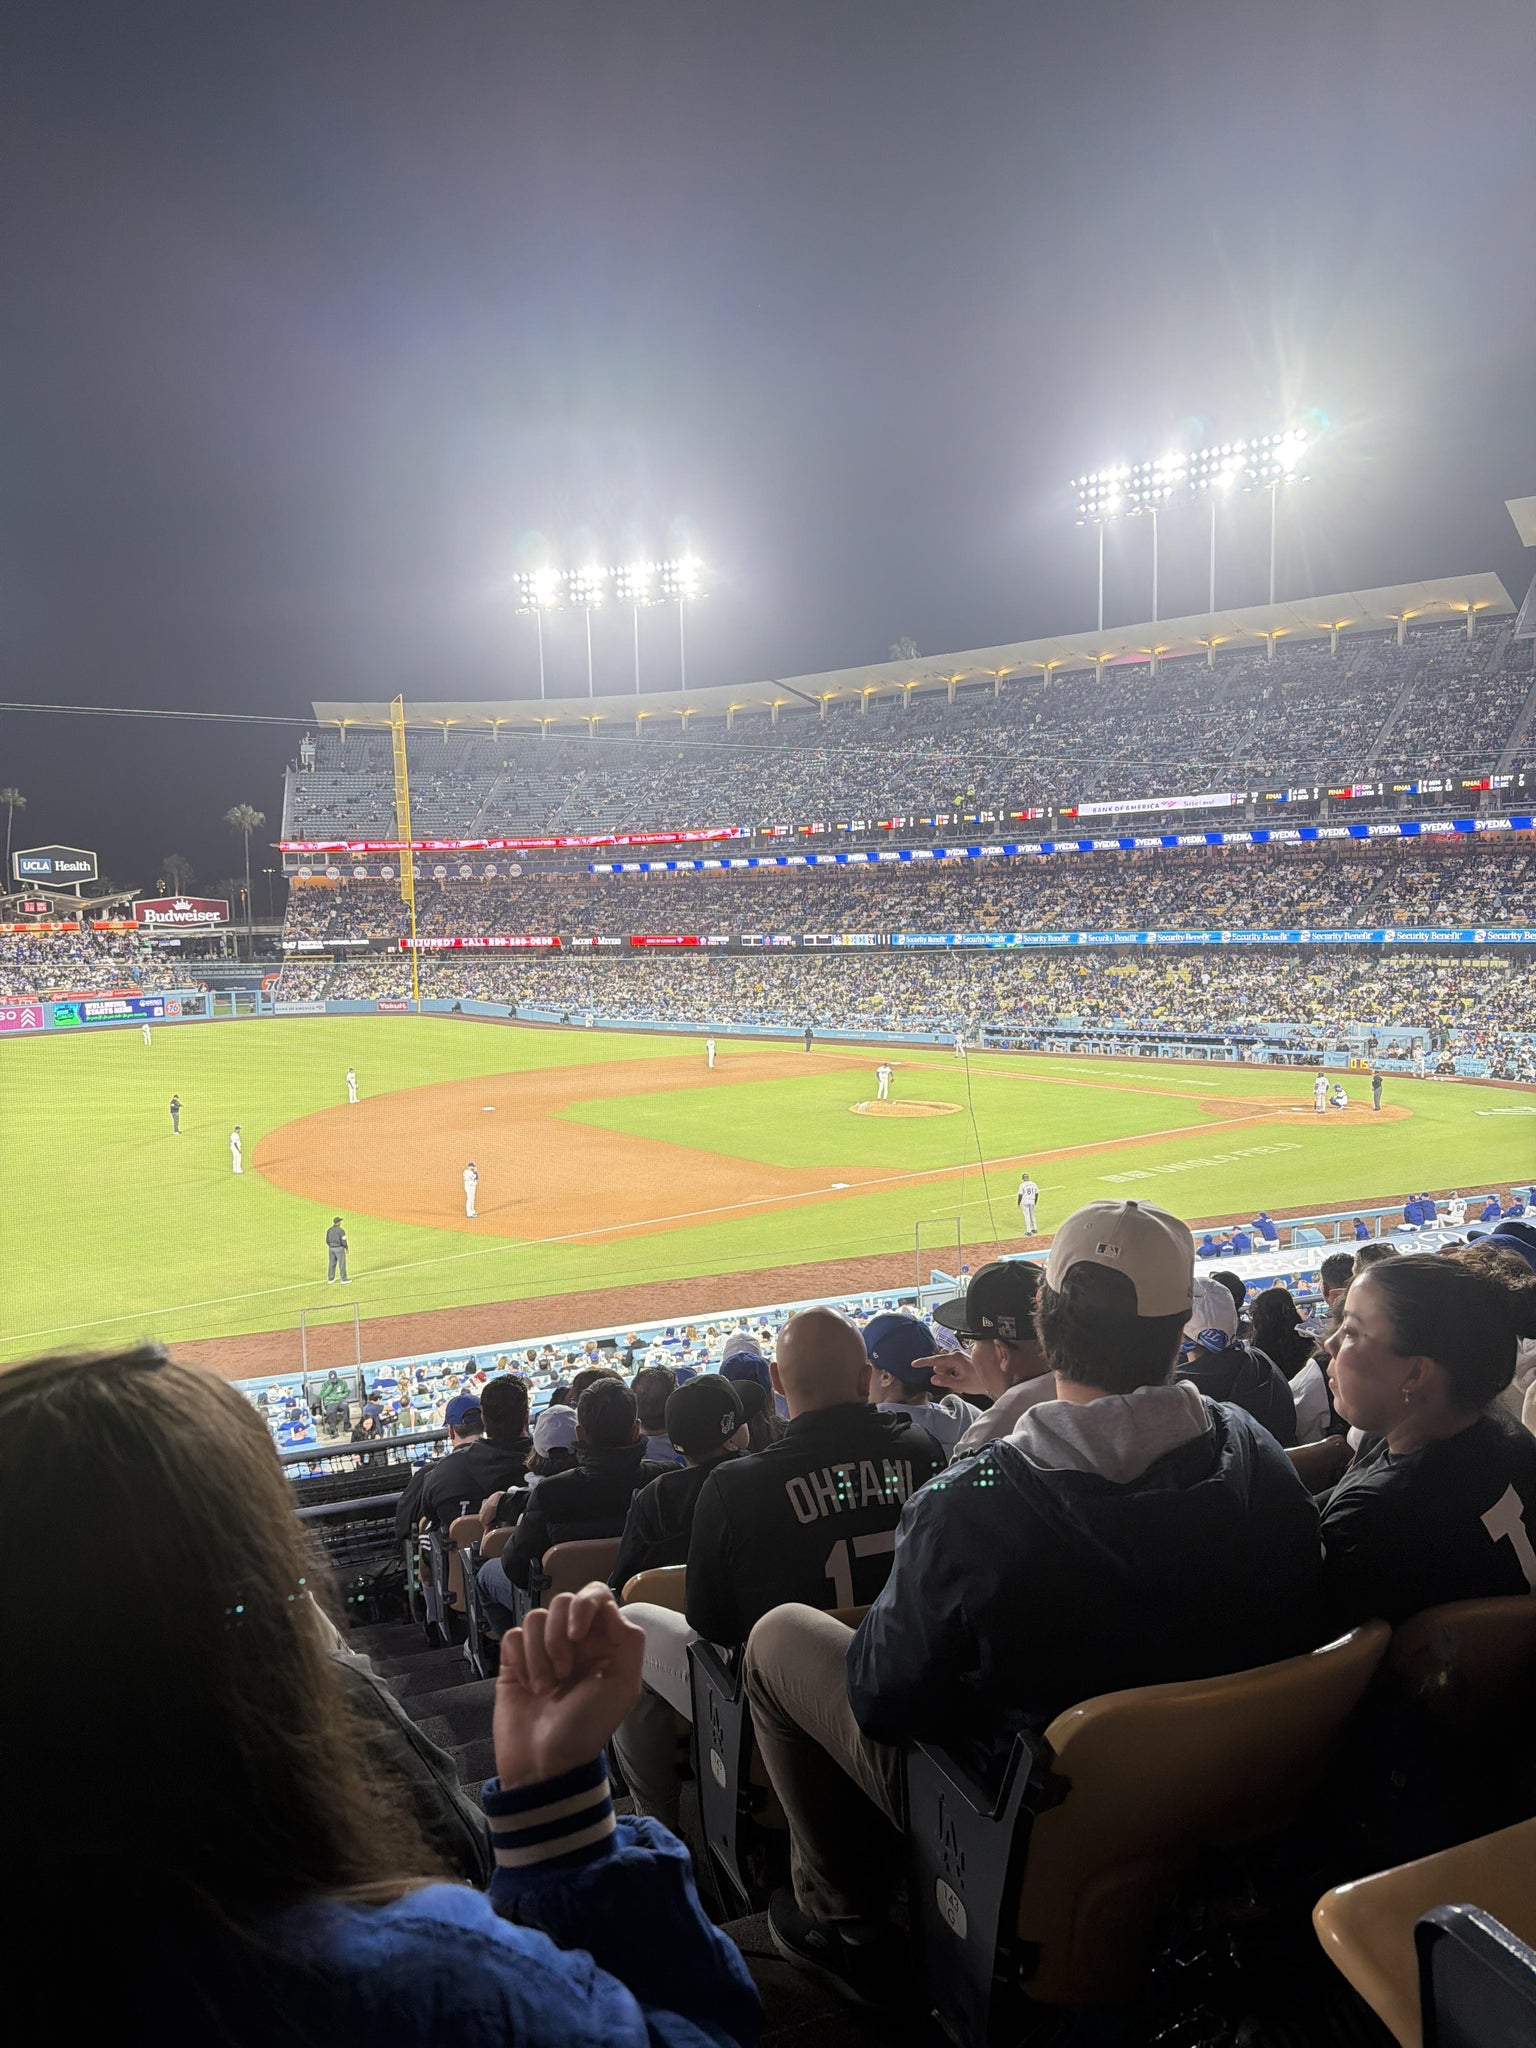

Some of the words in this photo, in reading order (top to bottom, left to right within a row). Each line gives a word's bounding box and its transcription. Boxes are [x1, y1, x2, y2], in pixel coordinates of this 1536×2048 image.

[1092, 806, 1113, 814] BANK
[1126, 803, 1160, 811] AMERICA
[1420, 822, 1455, 832] SVEDKA
[1475, 820, 1512, 829] SVEDKA
[1318, 828, 1351, 837] SVEDKA
[1368, 825, 1402, 834] SVEDKA
[1178, 835, 1207, 844] SVEDKA
[1223, 833, 1253, 841] SVEDKA
[1269, 831, 1301, 840] SVEDKA
[1054, 842, 1080, 850] SVEDKA
[1094, 840, 1120, 848] SVEDKA
[1135, 838, 1163, 846] SVEDKA
[22, 861, 50, 871] UCLA
[54, 861, 91, 872] Health
[144, 909, 221, 922] Budweiser
[1088, 934, 1113, 943] Security
[1157, 934, 1184, 942] Security
[1232, 933, 1261, 942] Security
[1263, 933, 1288, 941] Benefit
[1312, 932, 1343, 941] Security
[1345, 932, 1371, 940] Benefit
[1397, 932, 1427, 940] Security
[1432, 932, 1461, 940] Benefit
[1487, 931, 1523, 941] Security
[461, 938, 486, 946] CALL
[167, 1004, 178, 1012] 76
[379, 1002, 408, 1010] Yakult
[1231, 1142, 1304, 1157] FIELD
[1456, 1204, 1465, 1213] 84
[785, 1458, 914, 1525] OHTANI
